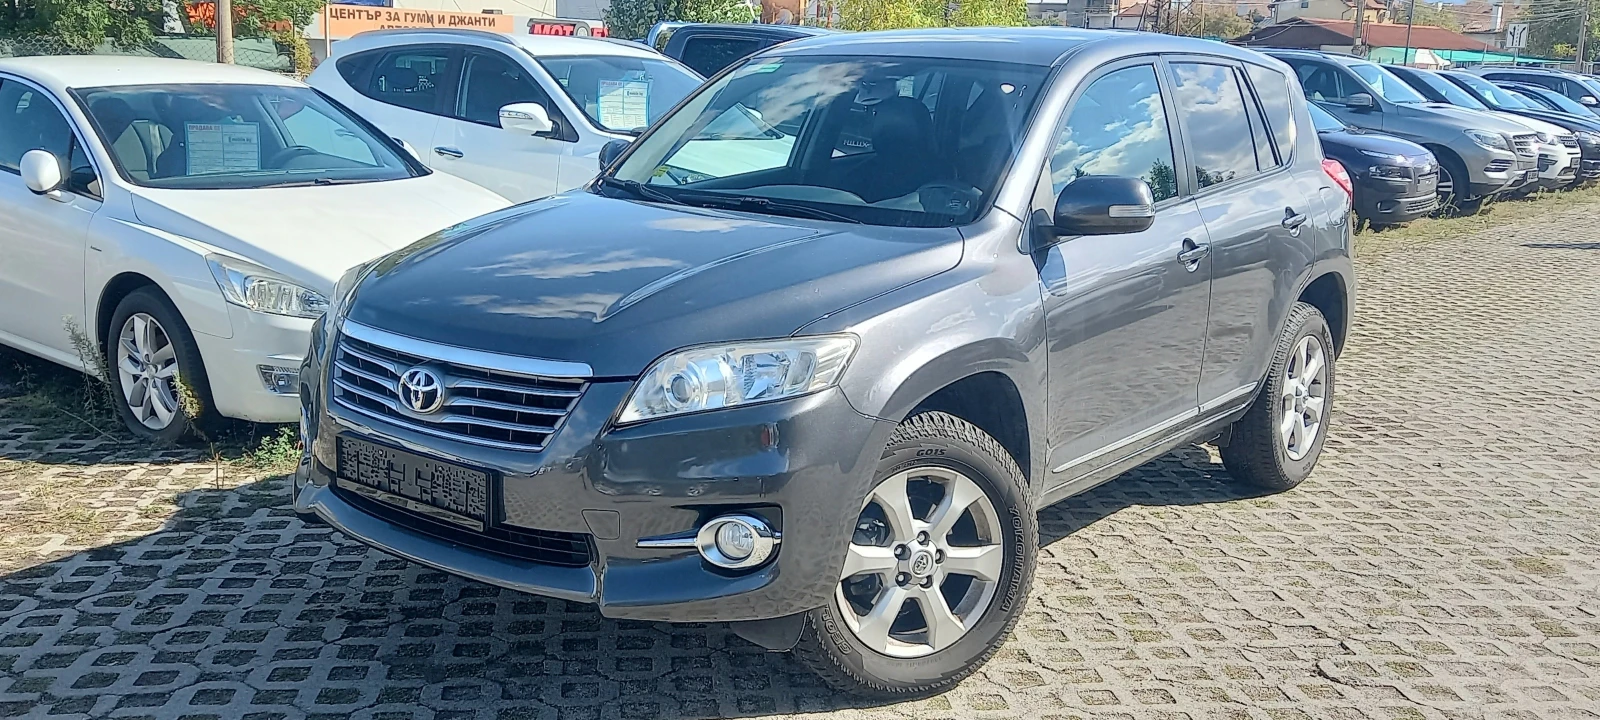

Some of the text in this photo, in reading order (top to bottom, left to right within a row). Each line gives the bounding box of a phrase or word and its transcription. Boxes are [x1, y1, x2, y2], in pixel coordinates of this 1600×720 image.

[330, 8, 495, 27] ЦЕНТЪР ЗА ГУМИ И ДЖАНТИ
[1001, 503, 1025, 613] YOKOHAMA
[822, 604, 852, 656] GEOL
